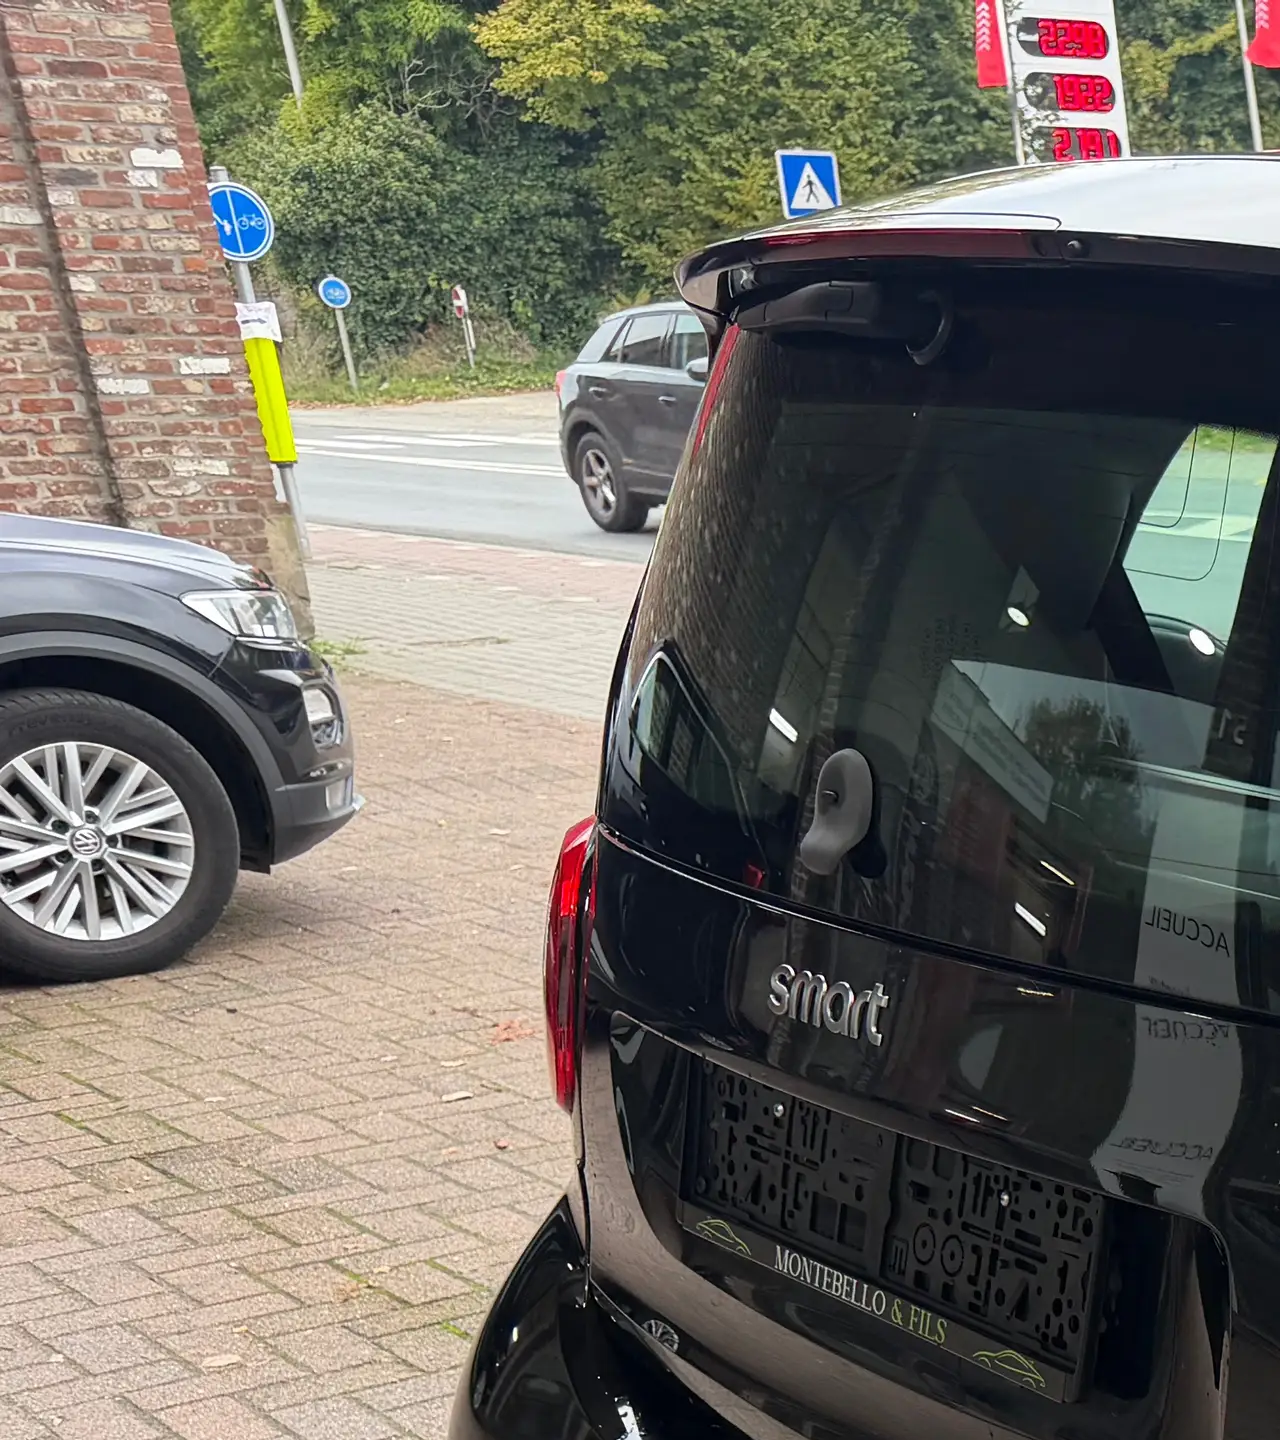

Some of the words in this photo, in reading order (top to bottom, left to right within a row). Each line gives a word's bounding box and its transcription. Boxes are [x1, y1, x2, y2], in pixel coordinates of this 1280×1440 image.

[767, 963, 889, 1046] smart
[774, 1245, 886, 1315] MONTEBELLO
[891, 1299, 903, 1326] &
[909, 1304, 948, 1344] FILS
